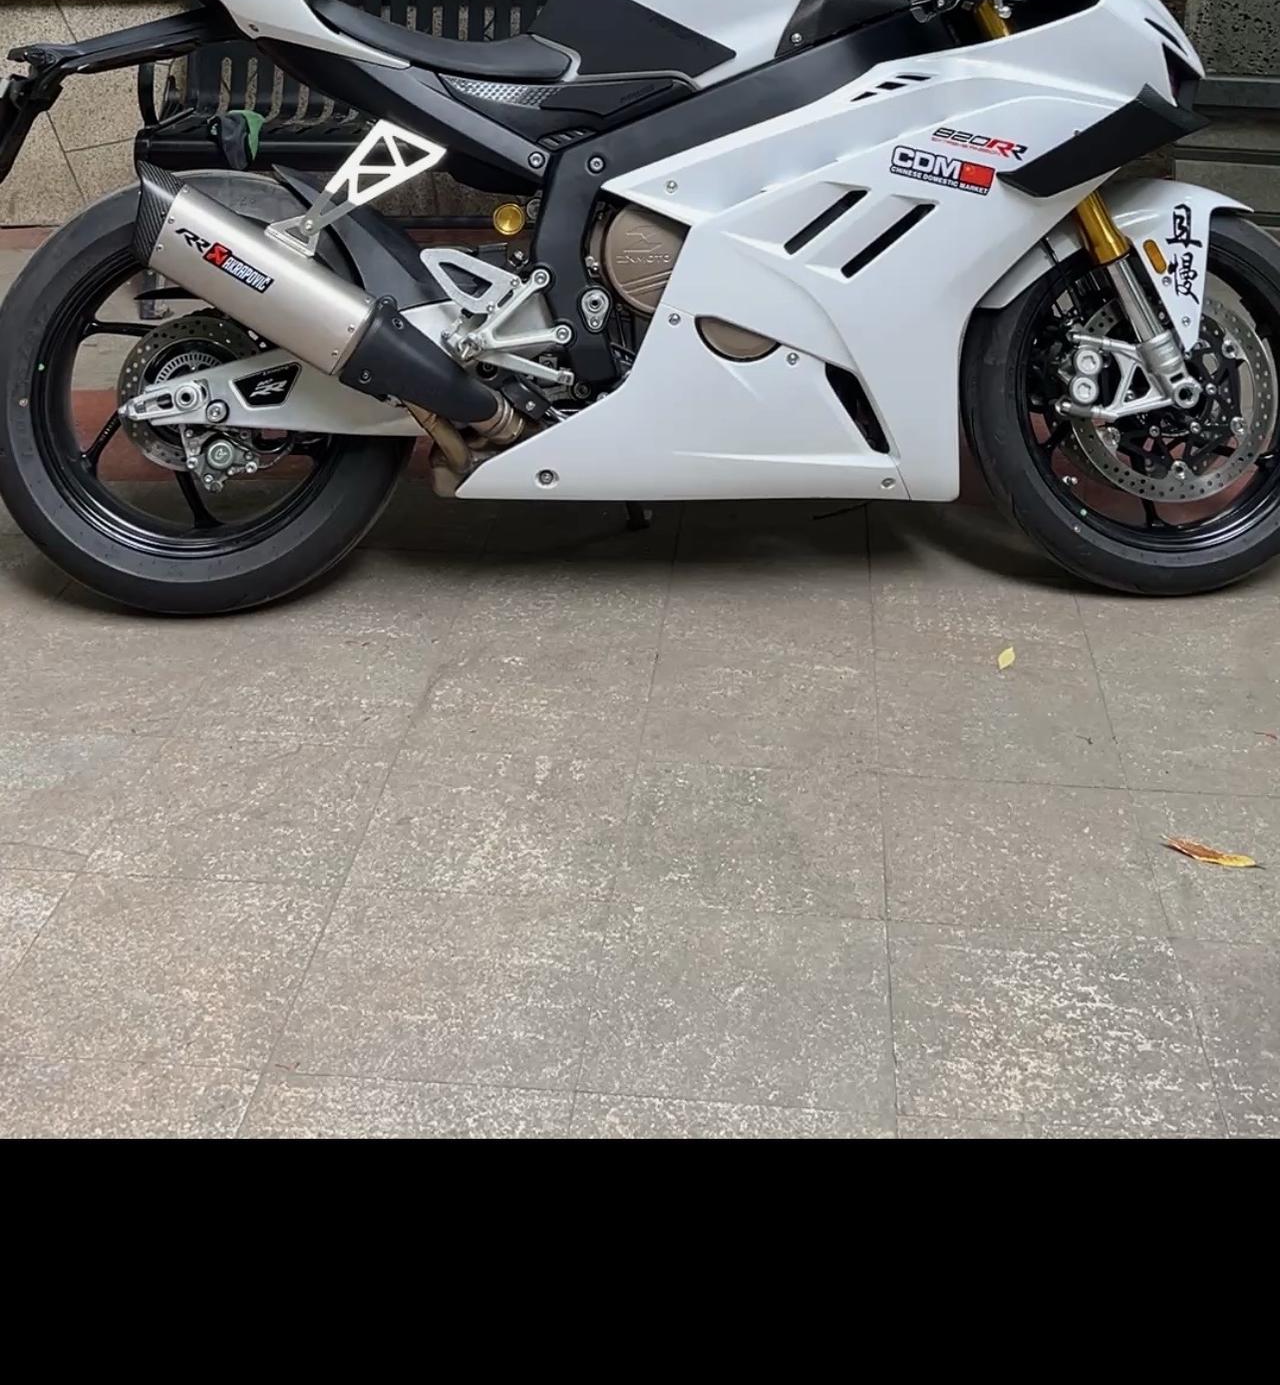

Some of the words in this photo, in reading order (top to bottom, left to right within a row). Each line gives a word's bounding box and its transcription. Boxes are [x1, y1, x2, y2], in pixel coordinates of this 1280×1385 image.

[892, 146, 963, 180] CDM
[890, 166, 922, 179] CHINESE
[922, 174, 959, 189] DOMESTIC
[959, 182, 989, 195] MARKET
